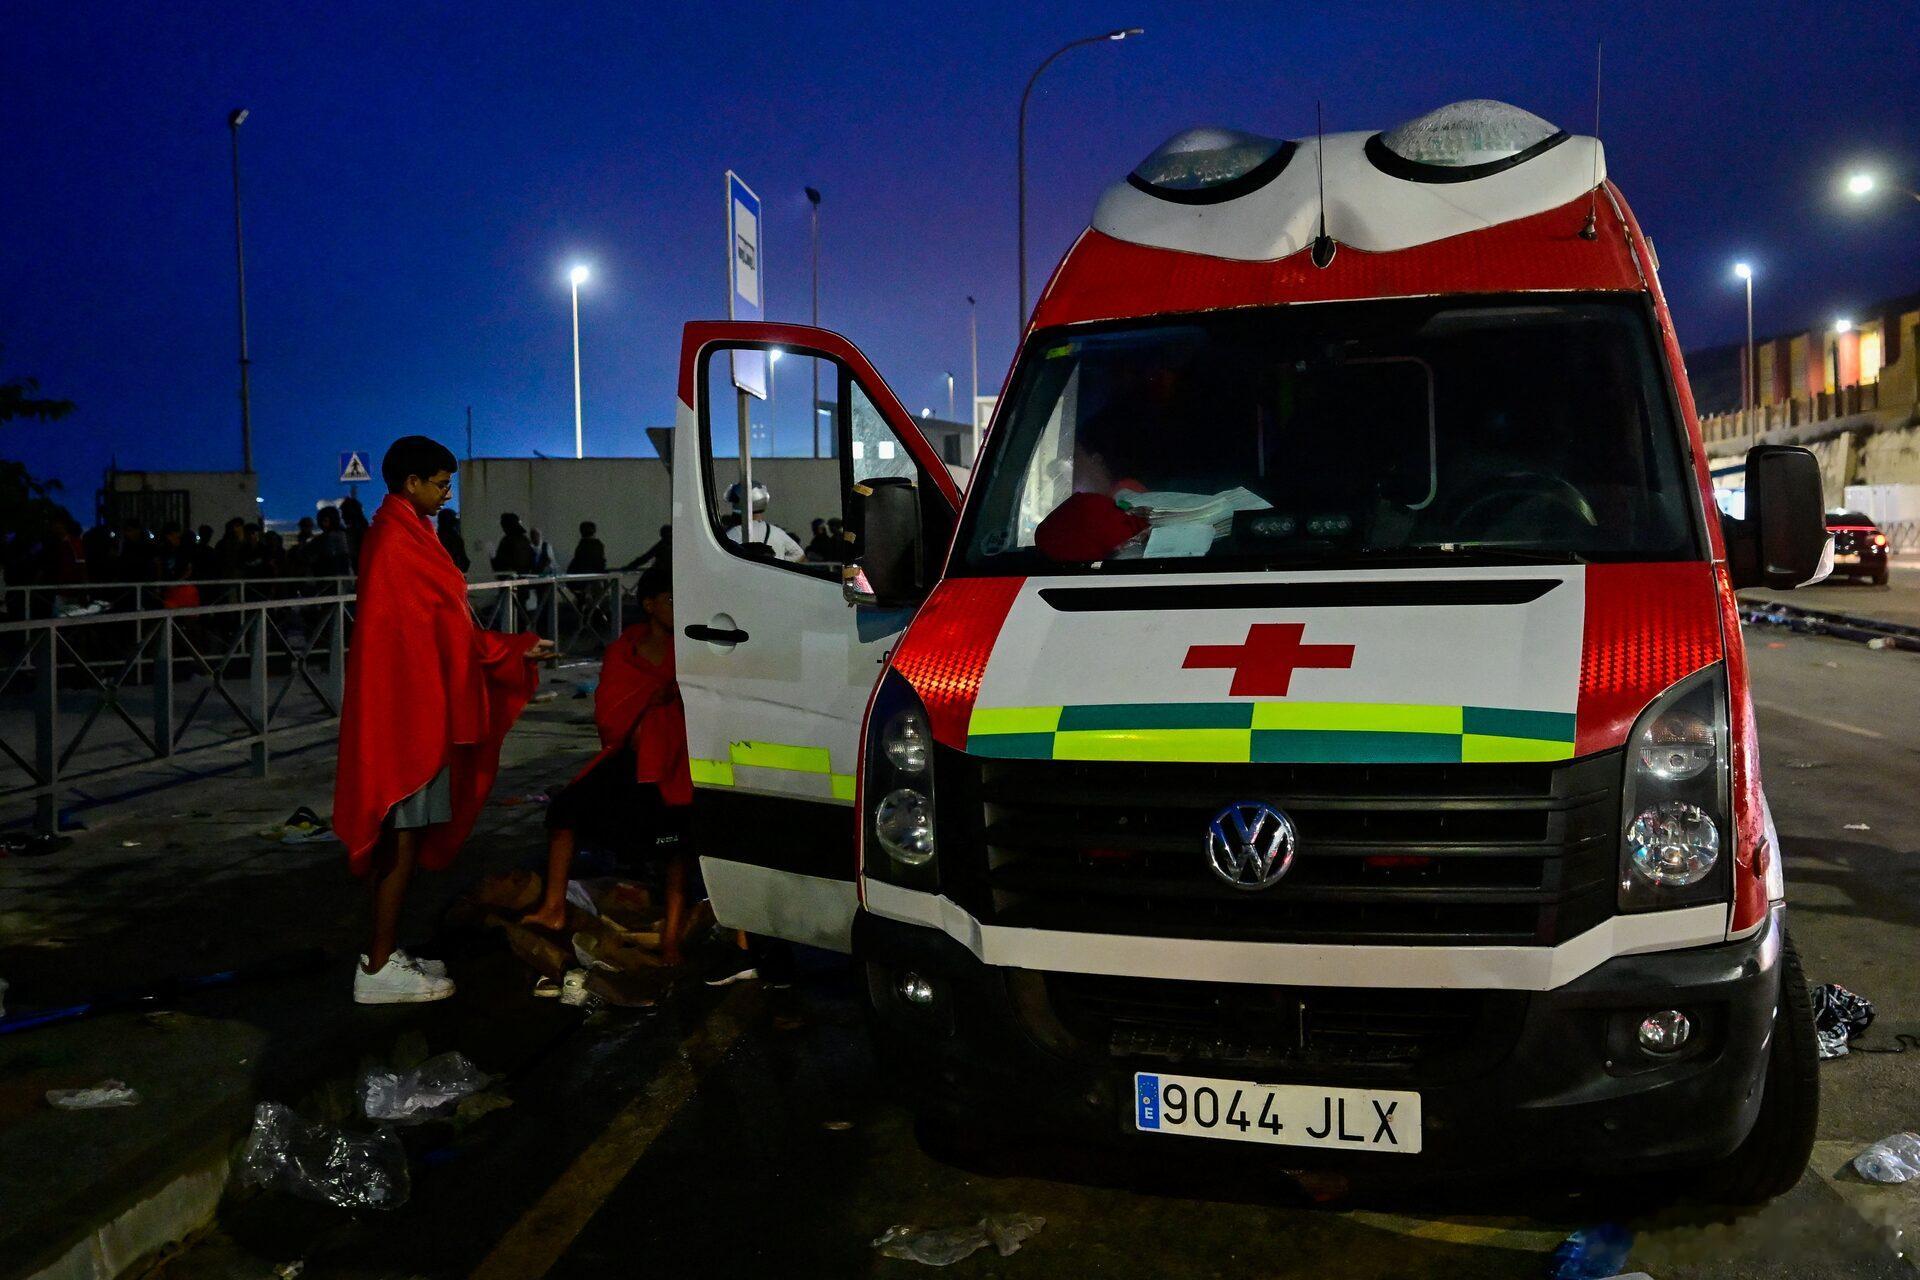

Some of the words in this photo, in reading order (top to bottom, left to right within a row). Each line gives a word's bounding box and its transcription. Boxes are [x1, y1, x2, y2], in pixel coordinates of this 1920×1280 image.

[1145, 1107, 1154, 1120] E
[1163, 1084, 1283, 1135] 9044
[1306, 1097, 1398, 1145] JLX
